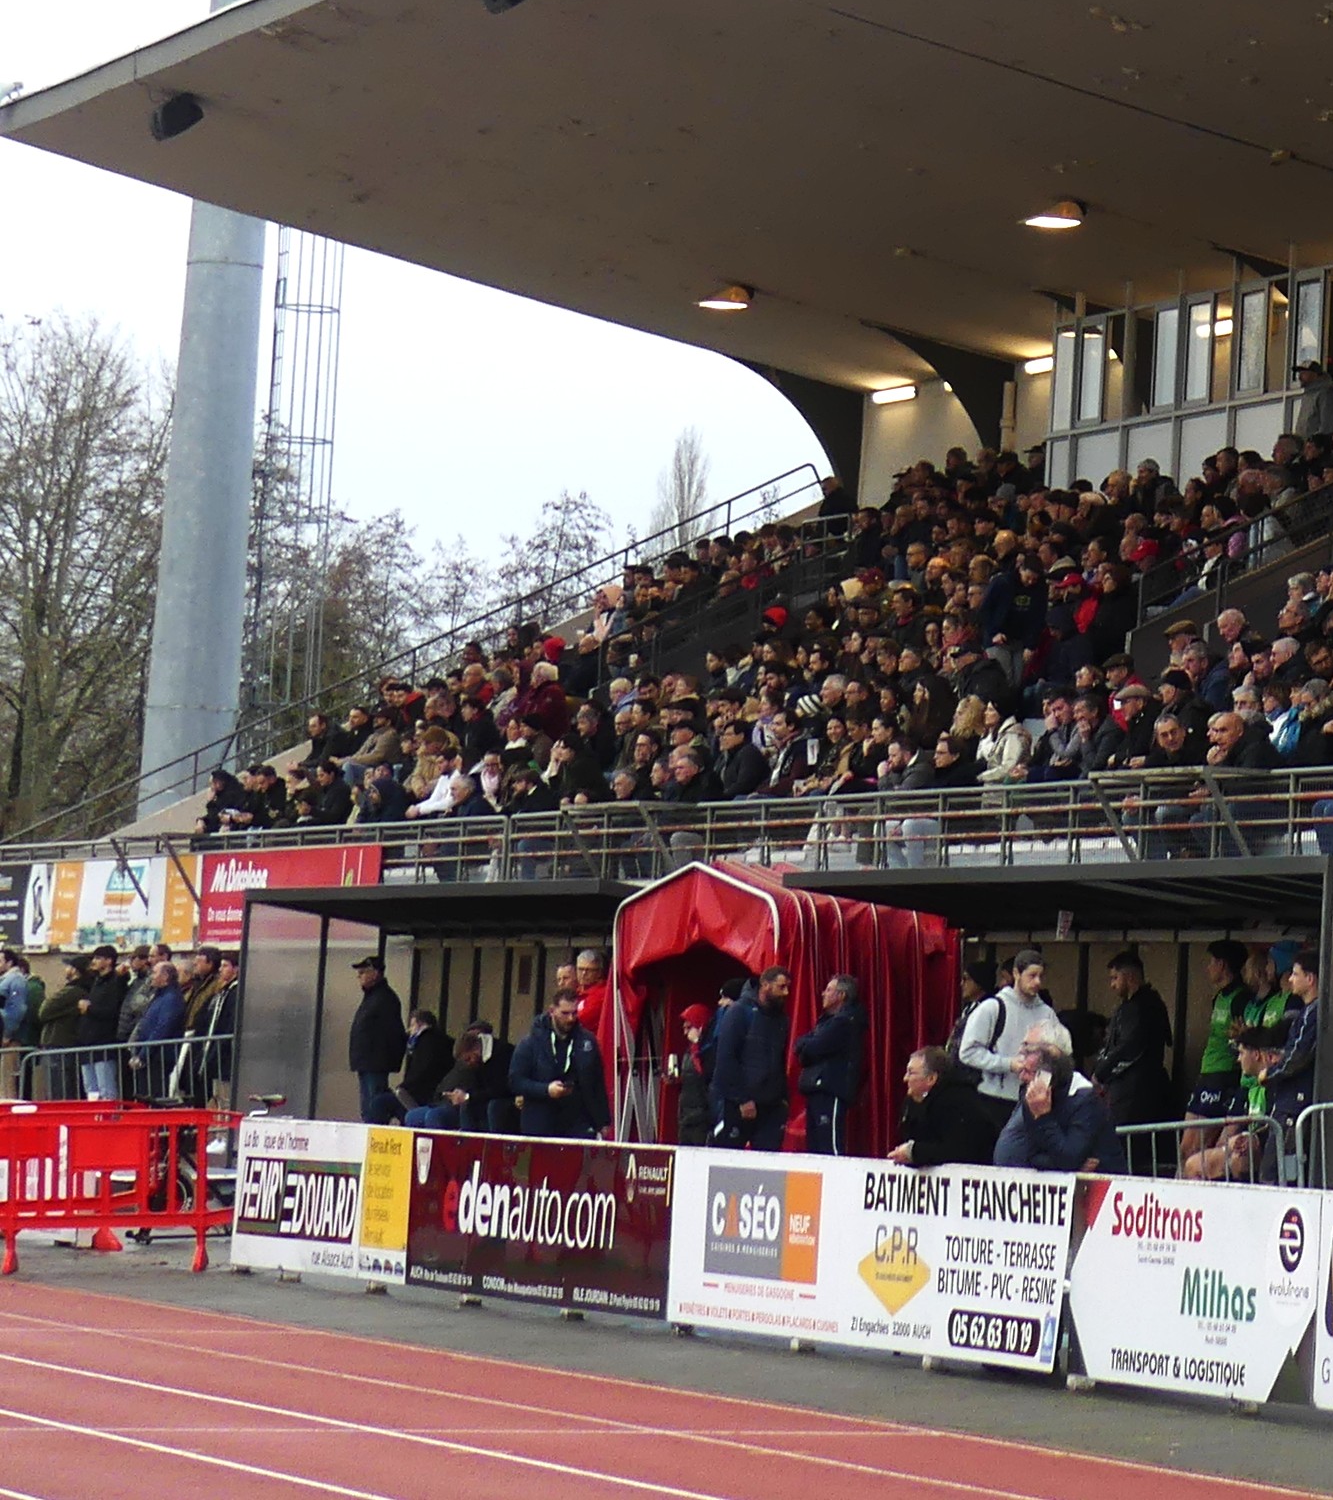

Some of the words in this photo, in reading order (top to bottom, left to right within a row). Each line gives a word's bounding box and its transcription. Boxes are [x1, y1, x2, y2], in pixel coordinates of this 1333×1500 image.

[280, 1172, 358, 1239] EDOUARD
[443, 1160, 616, 1250] edenauto.com
[712, 1184, 780, 1241] CASÉO
[863, 1172, 951, 1217] BATIMENT
[961, 1178, 1068, 1227] ETANCHEITE
[1112, 1190, 1203, 1243] Soditrans
[945, 1235, 994, 1265] TOITURE
[1003, 1240, 1057, 1271] TERRASSE
[937, 1267, 981, 1297] BITUME
[991, 1272, 1013, 1301] PVC
[1021, 1276, 1057, 1305] RESINE
[1180, 1266, 1257, 1323] Milhas
[912, 1323, 931, 1340] AUCH
[952, 1312, 968, 1345] 05
[970, 1315, 986, 1348] 62
[987, 1317, 1002, 1350] 63
[1004, 1319, 1018, 1352] 10
[1020, 1322, 1033, 1354] 19
[1111, 1348, 1171, 1379] TRANSPORT
[1173, 1356, 1181, 1379] &
[1184, 1358, 1246, 1388] LOGISTIQUE
